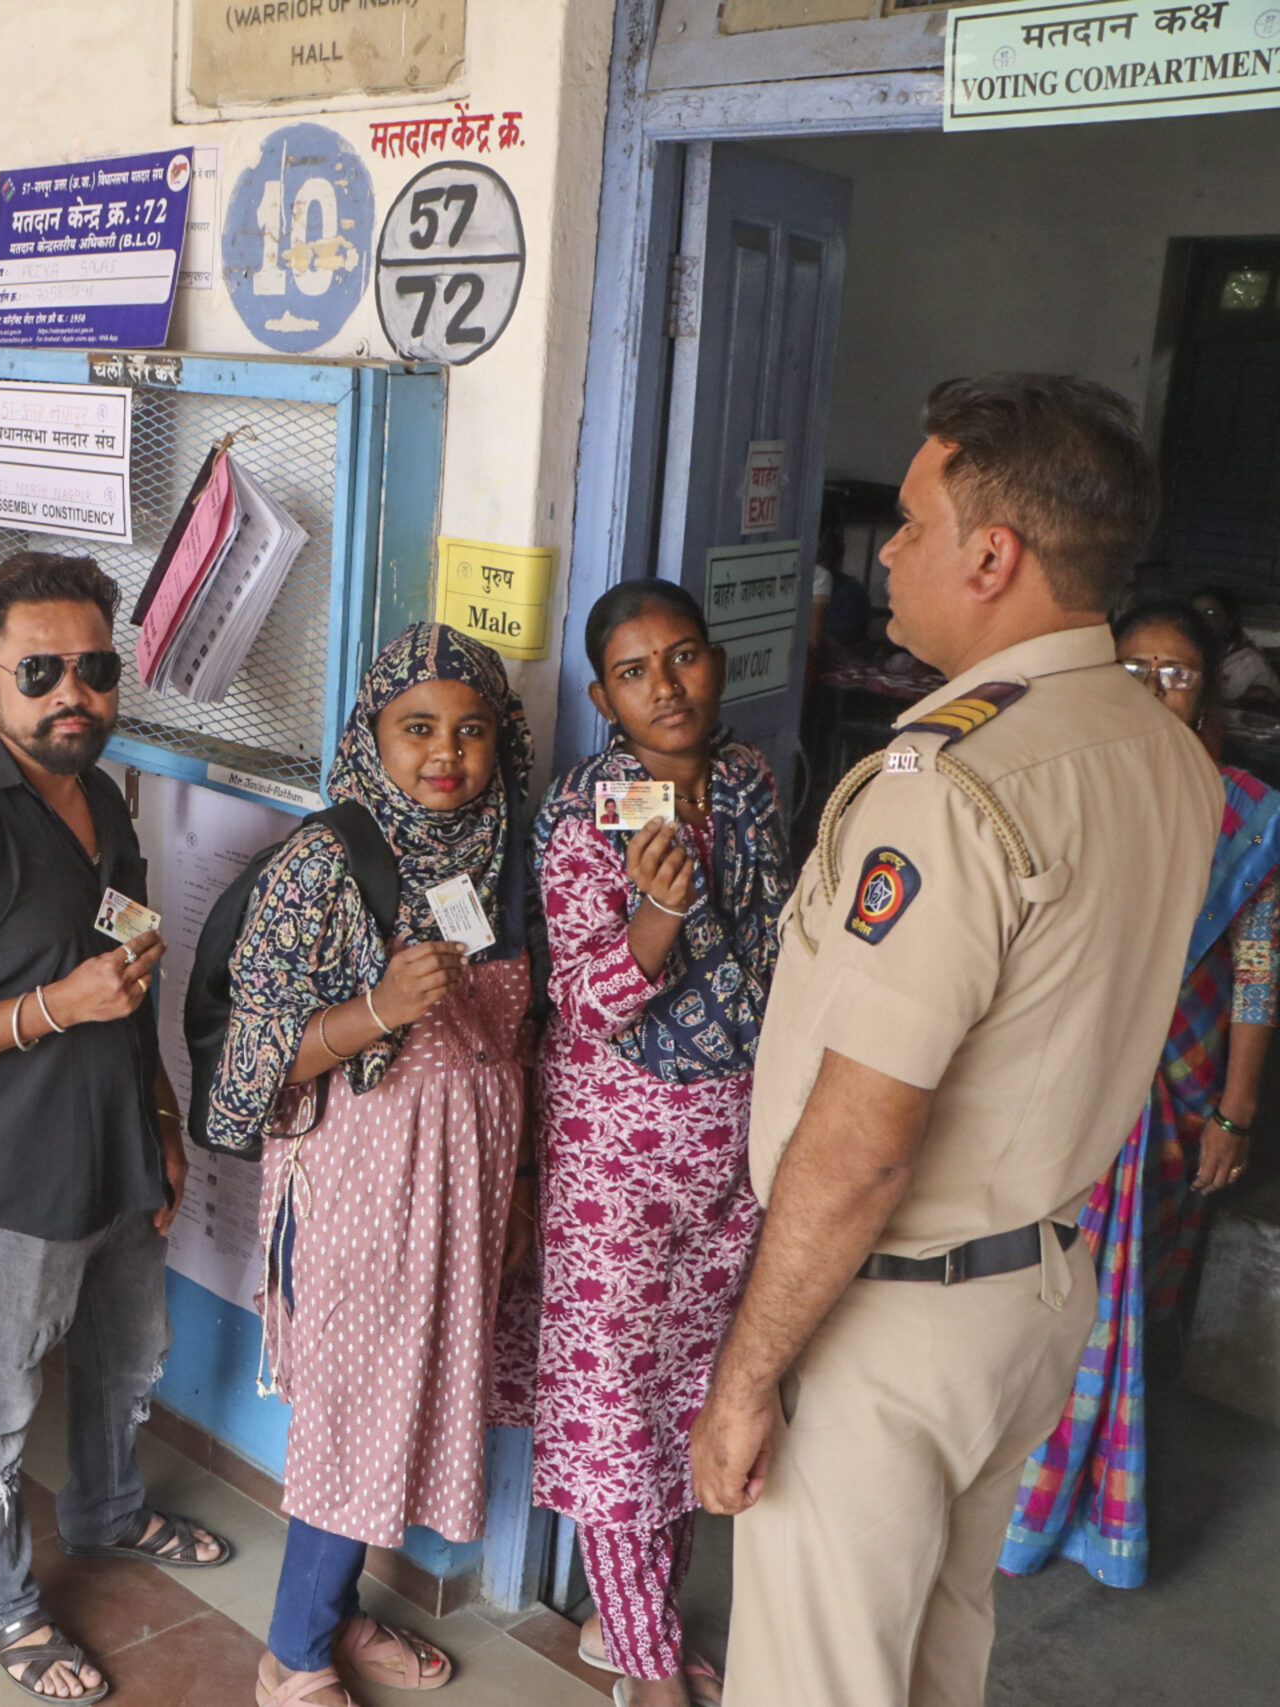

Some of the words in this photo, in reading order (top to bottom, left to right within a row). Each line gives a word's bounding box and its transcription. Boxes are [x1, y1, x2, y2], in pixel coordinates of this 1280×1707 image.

[1021, 12, 1138, 48] मतदान
[1154, 1, 1229, 35] कक्ष
[291, 41, 343, 66] HALL
[961, 70, 1057, 101] VOTING
[1065, 46, 1280, 93] COMPARTMEN
[370, 118, 453, 158] मतदान
[11, 207, 63, 234] मतदान
[409, 184, 478, 250] 57
[396, 273, 485, 346] 72
[52, 430, 89, 449] मतदार
[95, 430, 115, 450] संघ
[42, 504, 115, 525] CONSTITUENCY
[748, 496, 778, 523] EXIT
[481, 565, 514, 594] पुरुष
[467, 605, 521, 637] Male
[751, 648, 772, 677] OUT
